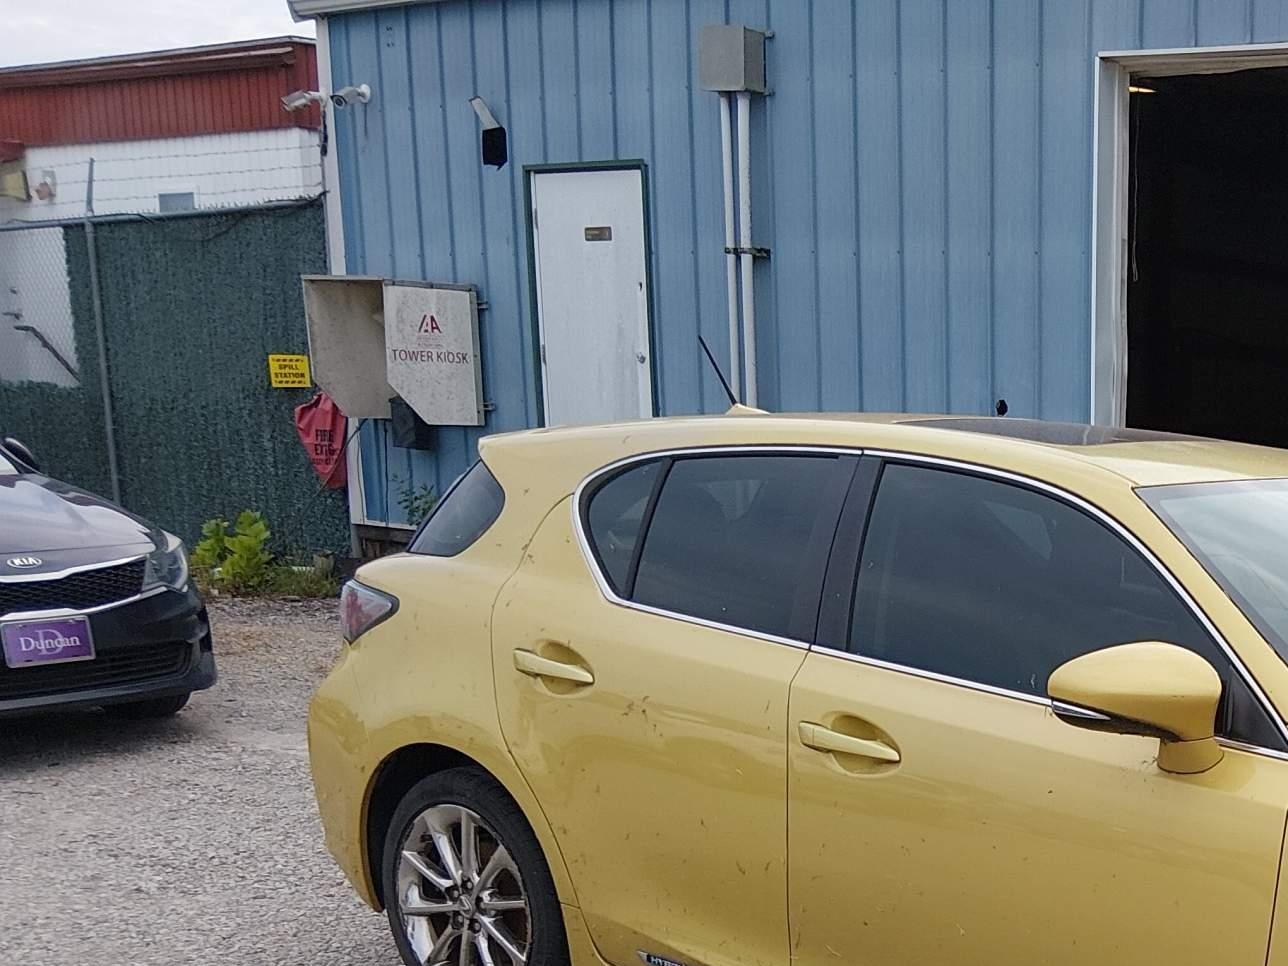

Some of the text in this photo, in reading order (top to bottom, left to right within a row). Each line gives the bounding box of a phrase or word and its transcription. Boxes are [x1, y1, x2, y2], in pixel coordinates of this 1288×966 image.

[392, 348, 469, 364] TOWER KIOSK
[315, 428, 335, 443] FIRE
[19, 636, 80, 652] Duncan
